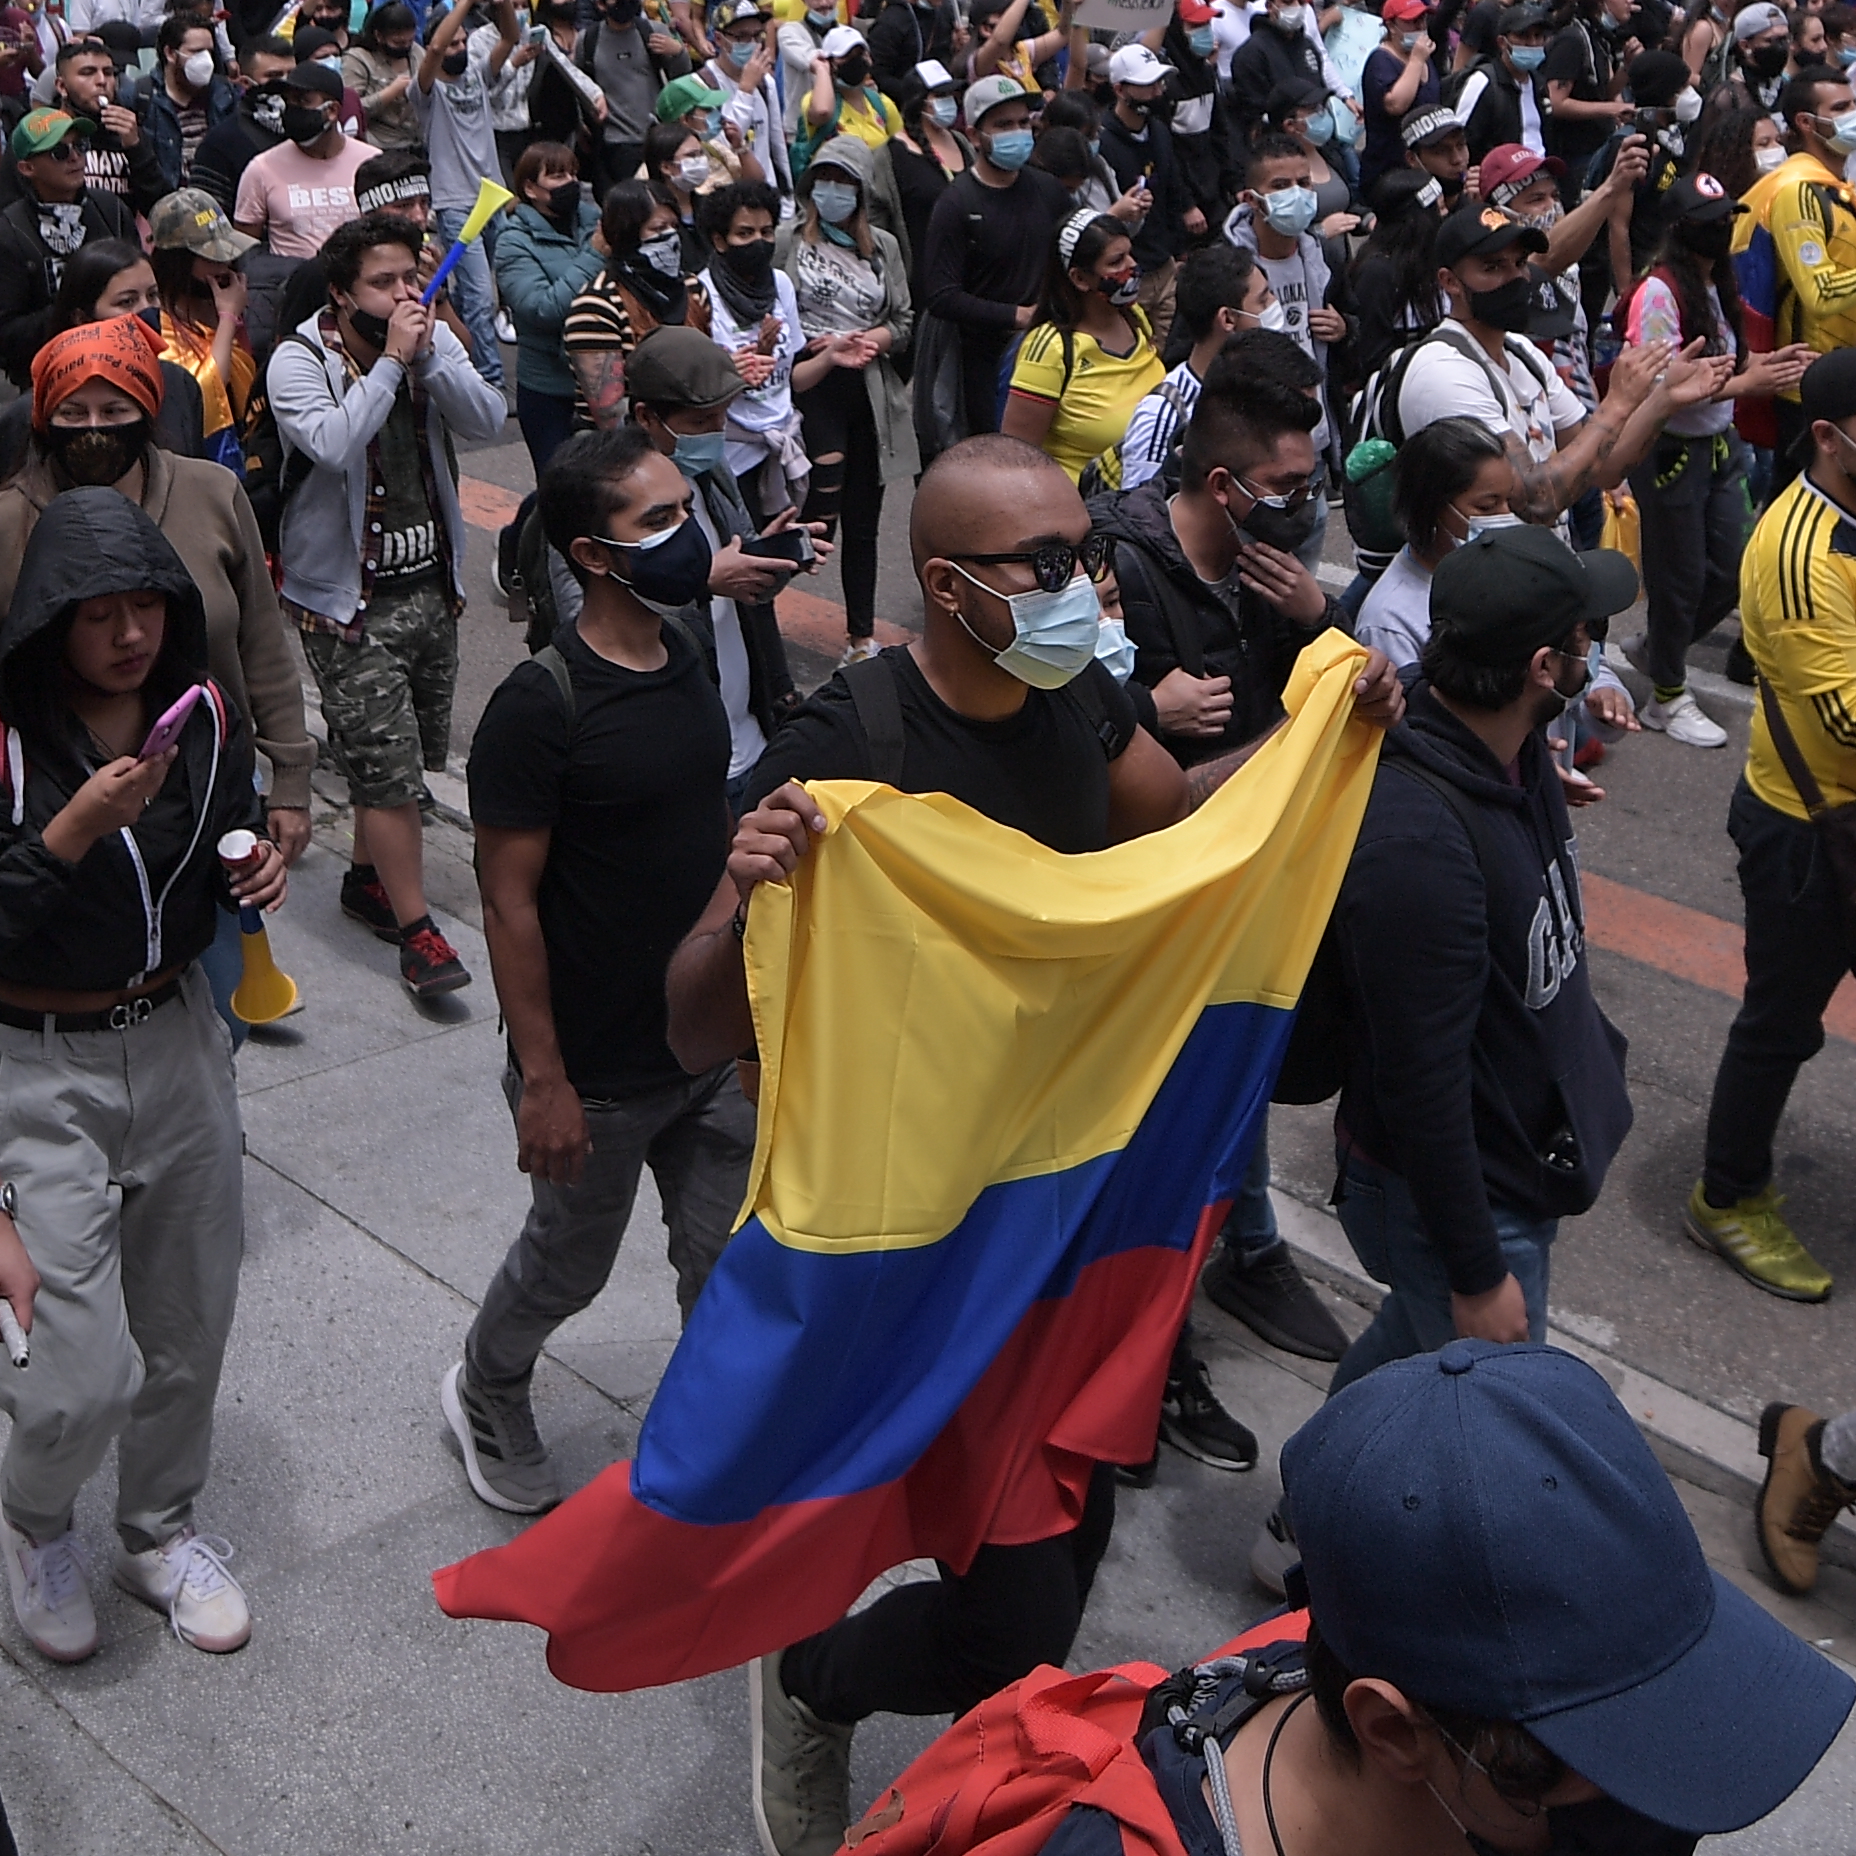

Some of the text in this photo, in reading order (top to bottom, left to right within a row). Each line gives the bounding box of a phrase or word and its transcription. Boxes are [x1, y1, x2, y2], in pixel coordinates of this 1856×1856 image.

[1411, 114, 1435, 139] NO
[289, 186, 355, 209] BES
[368, 182, 396, 210] NO
[1058, 226, 1081, 258] NO
[1525, 834, 1586, 1011] GA
